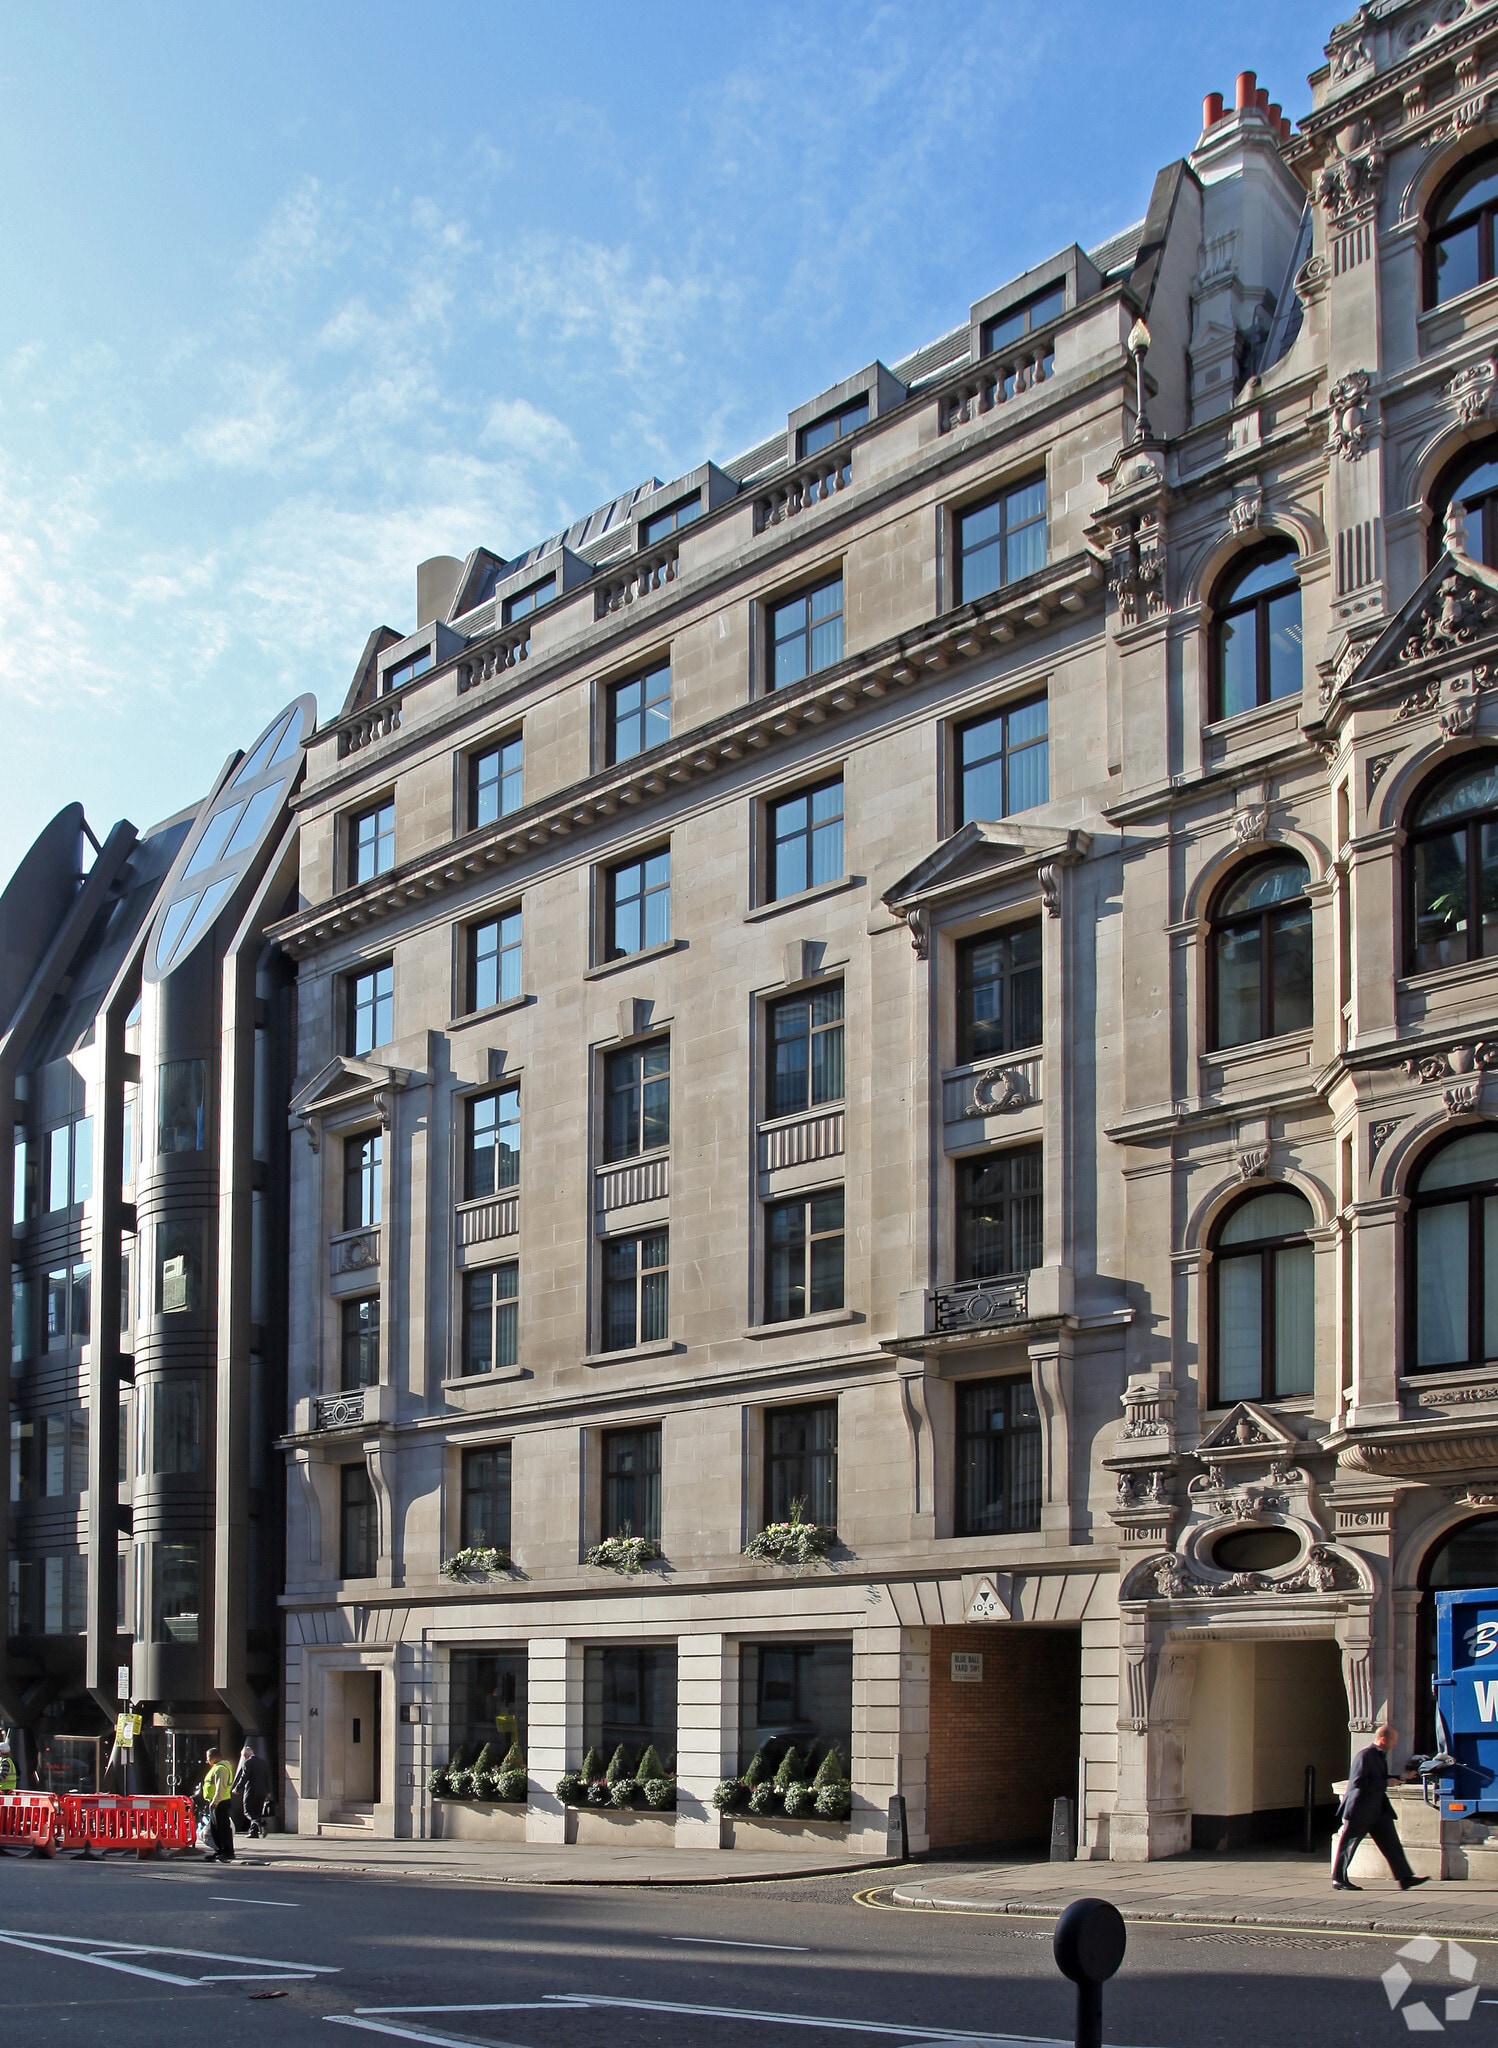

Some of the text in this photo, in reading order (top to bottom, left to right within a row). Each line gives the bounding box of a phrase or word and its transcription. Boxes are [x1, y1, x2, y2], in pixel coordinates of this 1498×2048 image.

[955, 1655, 979, 1664] BLUE BALL
[955, 1664, 968, 1672] YARD
[309, 1707, 318, 1717] 64
